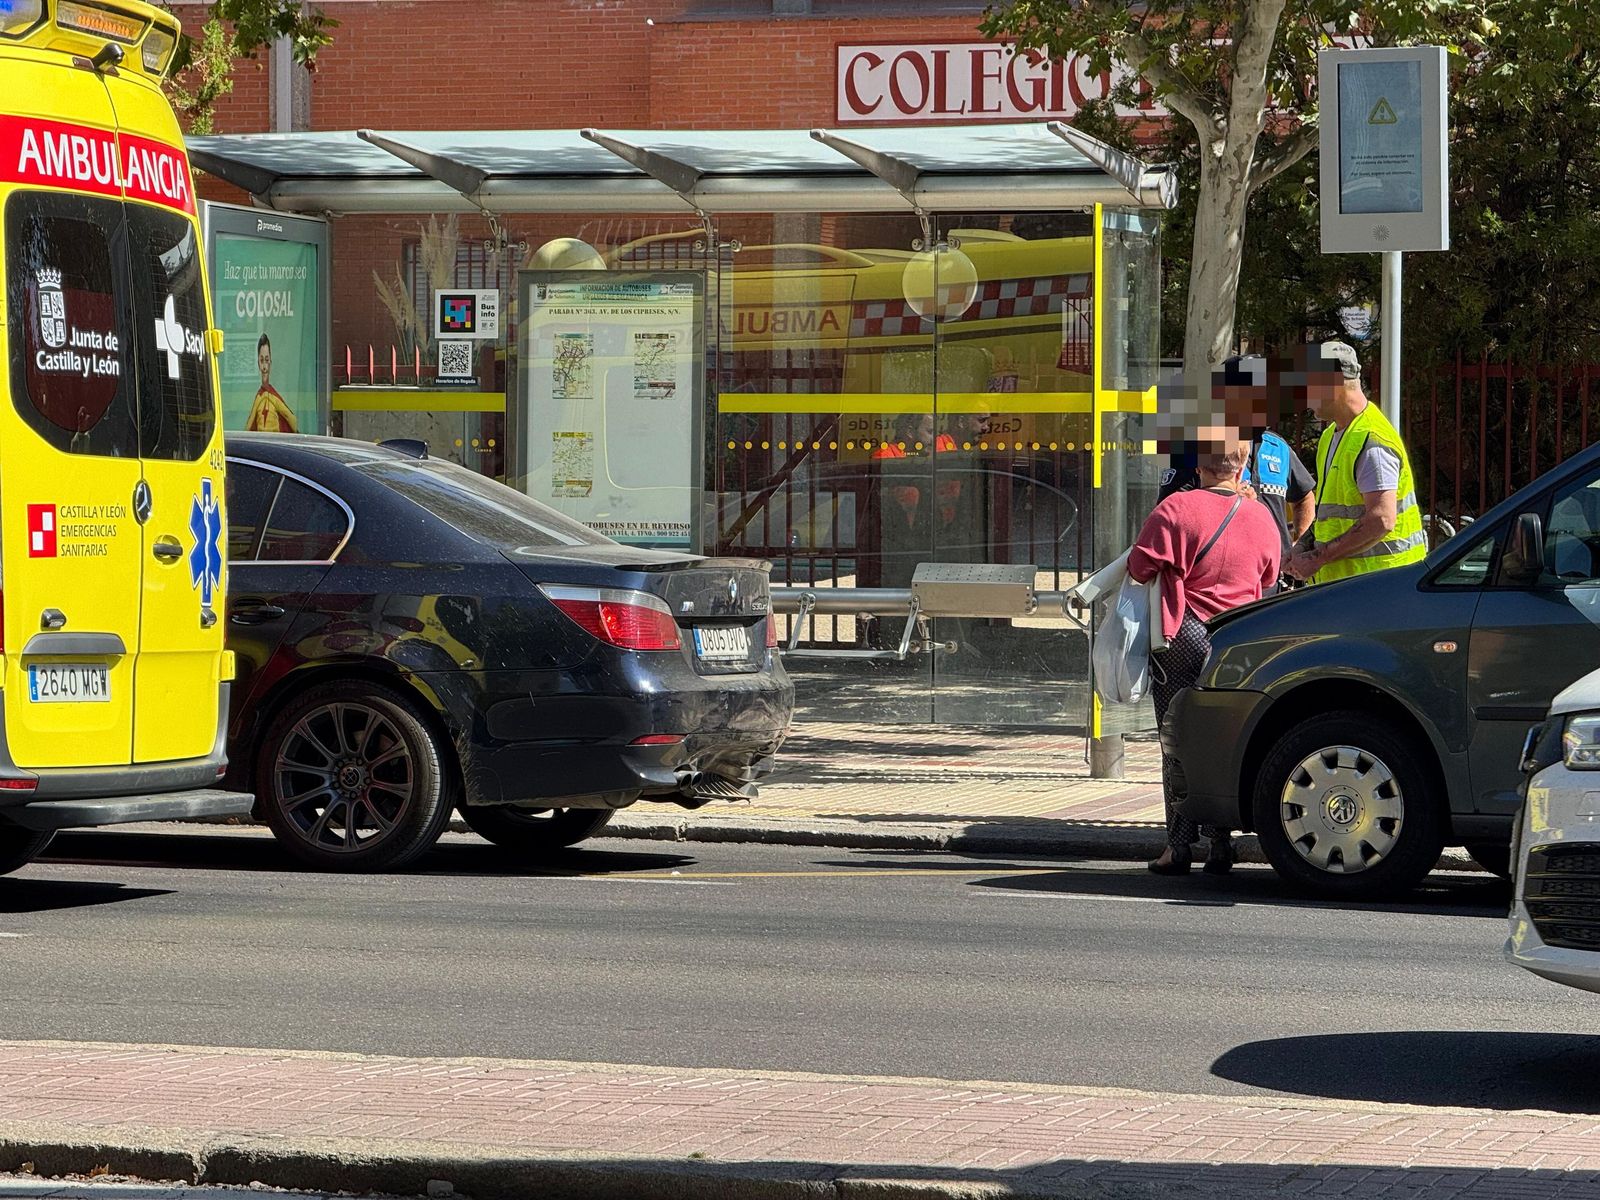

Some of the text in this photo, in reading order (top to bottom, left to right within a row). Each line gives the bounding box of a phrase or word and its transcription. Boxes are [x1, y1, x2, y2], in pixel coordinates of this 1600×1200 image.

[844, 50, 1111, 115] COLEGIO
[18, 128, 189, 203] AMBULANCIA
[224, 260, 241, 279] Haz
[242, 265, 257, 286] que
[259, 264, 268, 280] tu
[235, 290, 294, 318] COLOSAL
[69, 326, 119, 350] Junta de
[185, 327, 206, 362] Sacyl
[36, 350, 119, 377] Castilla y León
[60, 503, 126, 519] CASTILLA Y LEÓN
[61, 525, 117, 537] EMERGENCIAS
[627, 521, 637, 529] EN
[640, 521, 650, 529] EL
[652, 521, 690, 529] REVERSO
[61, 544, 108, 557] SANITARIAS
[40, 668, 107, 696] 2640 MGW
